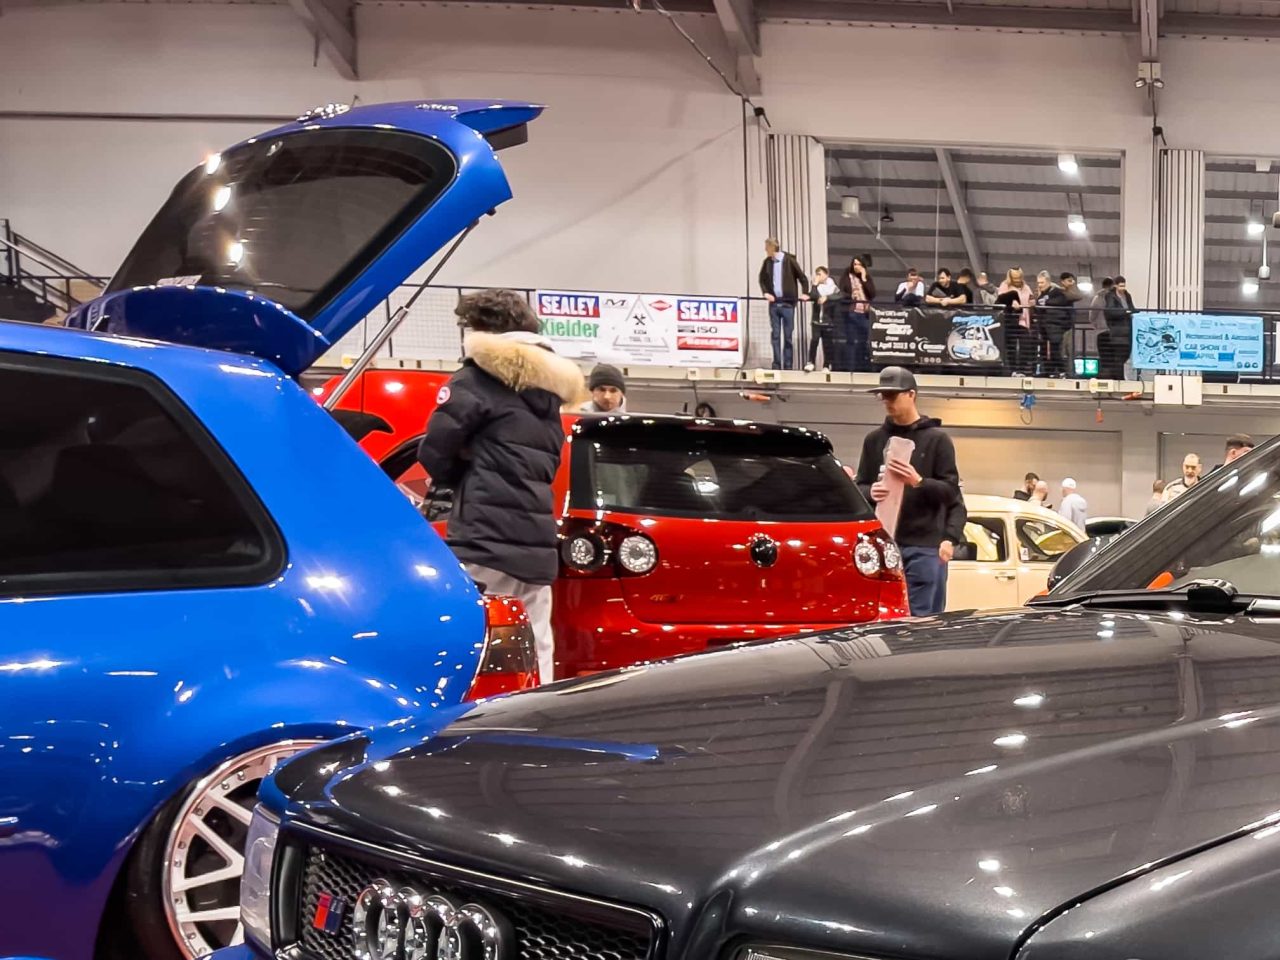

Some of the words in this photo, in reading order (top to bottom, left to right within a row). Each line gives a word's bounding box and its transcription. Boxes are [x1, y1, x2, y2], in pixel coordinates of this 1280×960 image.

[541, 296, 596, 316] SEALEY
[679, 301, 735, 321] SEALEY
[539, 319, 599, 338] Kielder
